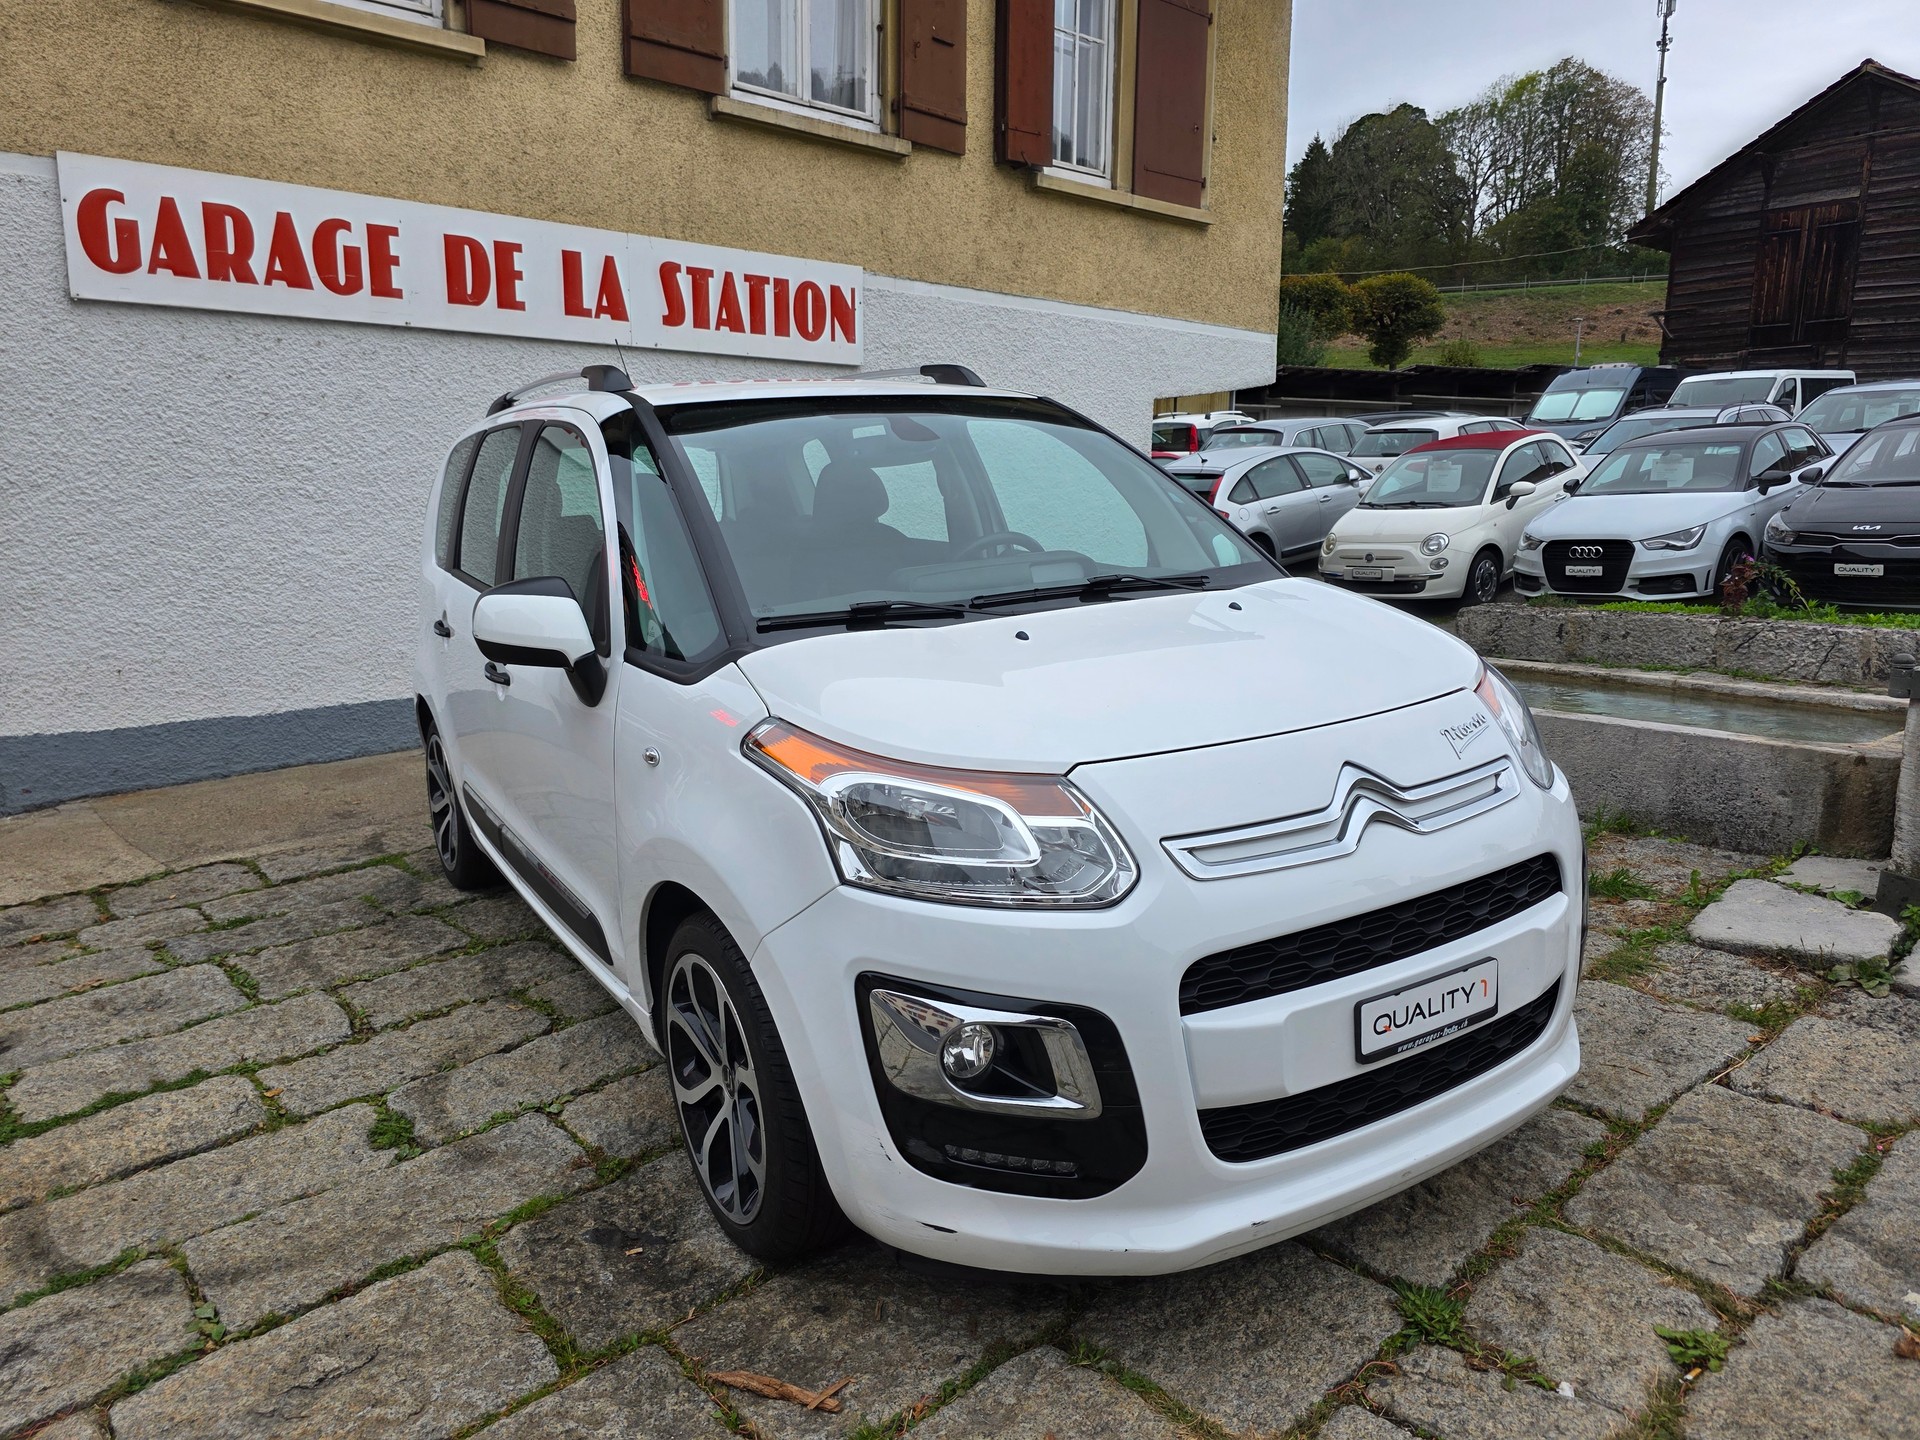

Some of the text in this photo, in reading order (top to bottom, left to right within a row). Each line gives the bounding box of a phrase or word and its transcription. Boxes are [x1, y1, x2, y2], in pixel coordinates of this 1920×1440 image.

[77, 187, 856, 344] GARAGE DE LA STATION
[1373, 979, 1488, 1035] QUALITY 1
